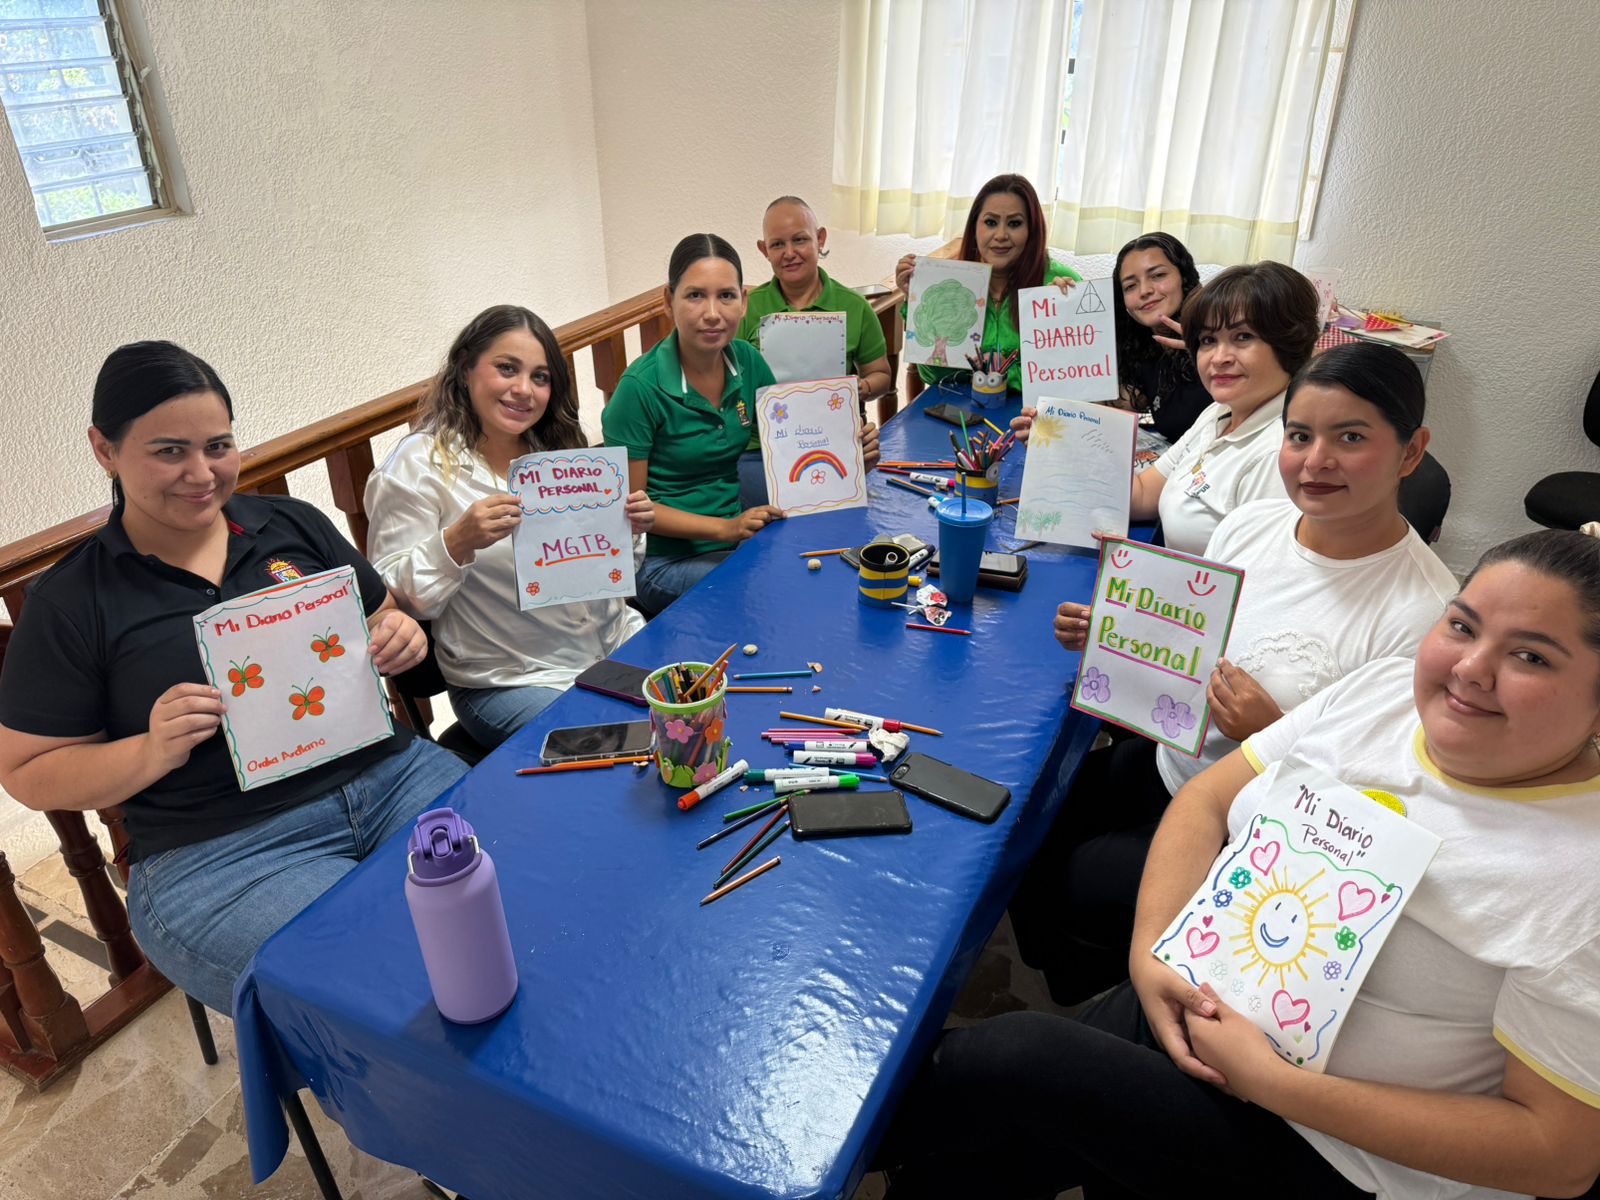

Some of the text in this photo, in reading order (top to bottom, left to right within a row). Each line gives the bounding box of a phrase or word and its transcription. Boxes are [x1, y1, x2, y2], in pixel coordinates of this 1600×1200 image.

[1032, 297, 1057, 318] Mi
[1033, 324, 1095, 349] DIARIO
[1027, 354, 1111, 383] Personal
[1045, 405, 1056, 416] Mi
[1057, 408, 1077, 418] Diario
[519, 467, 602, 485] MI DIARIO
[538, 482, 603, 499] PERSONAL
[542, 533, 612, 561] MGTB
[246, 609, 293, 629] Diario
[1097, 615, 1202, 677] Personal
